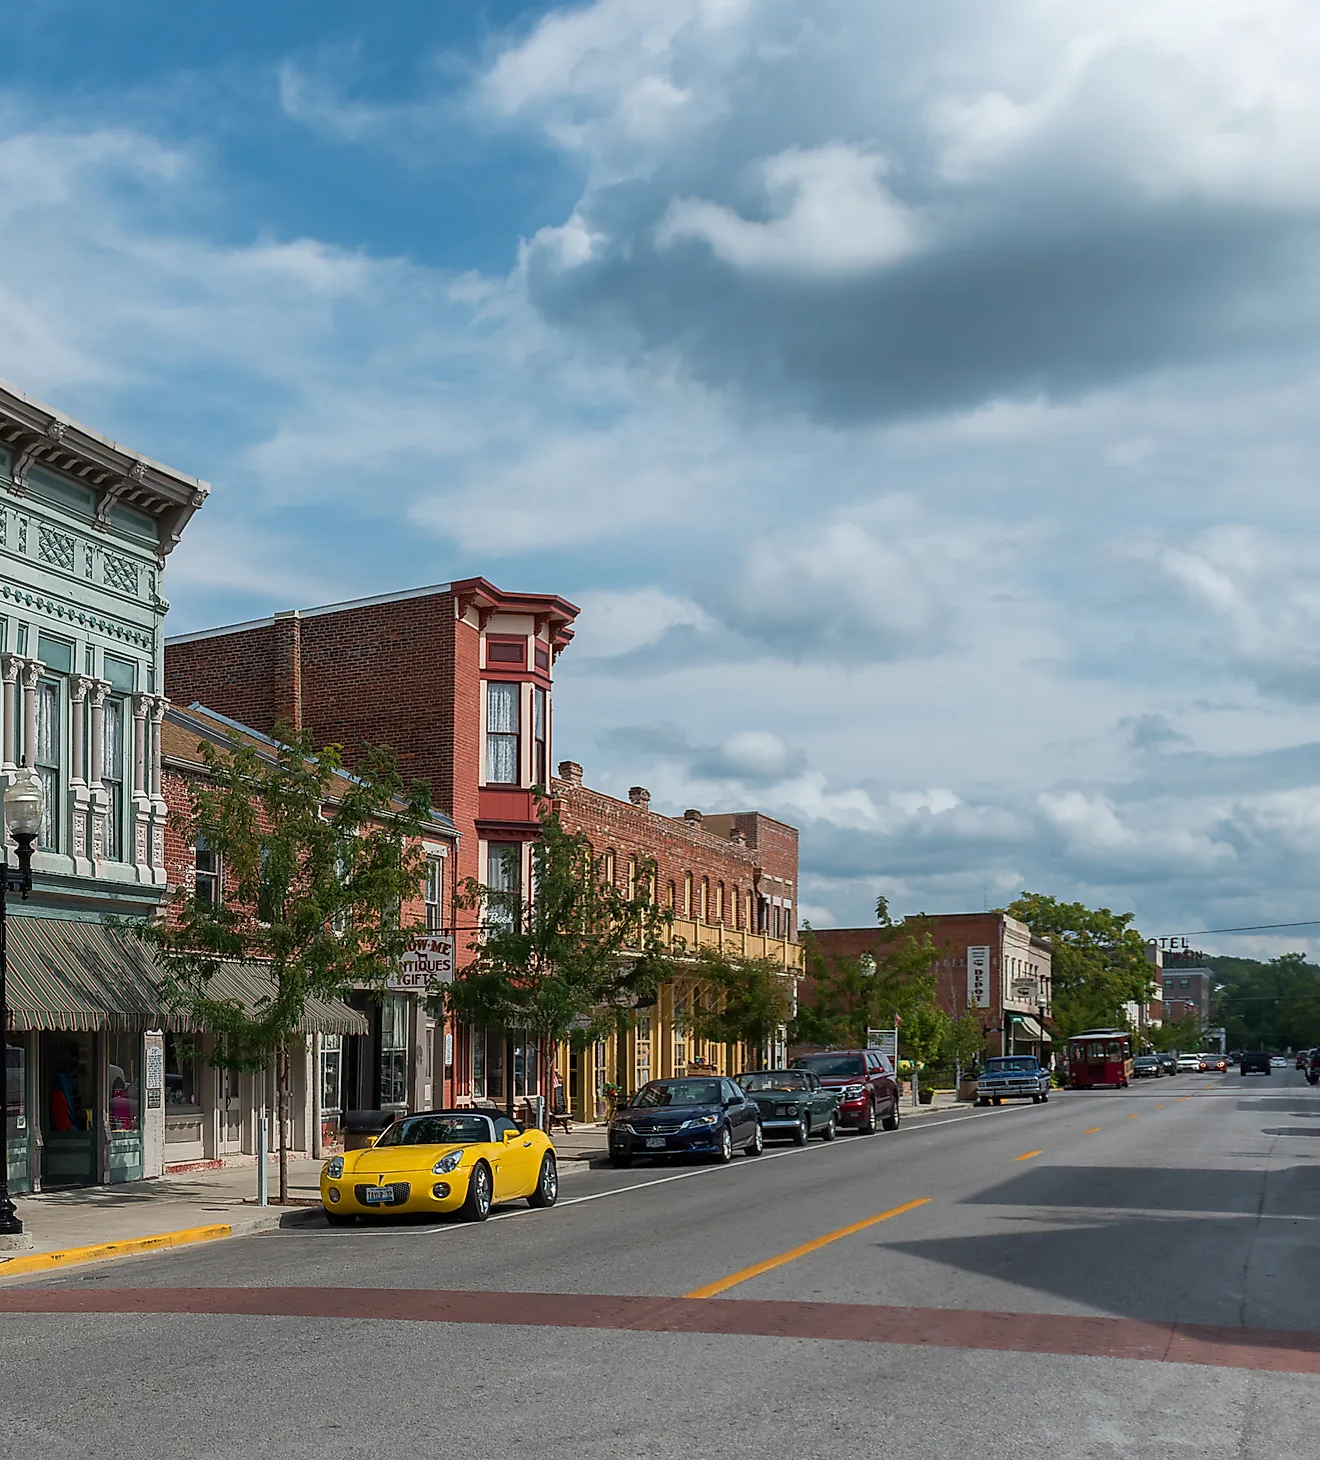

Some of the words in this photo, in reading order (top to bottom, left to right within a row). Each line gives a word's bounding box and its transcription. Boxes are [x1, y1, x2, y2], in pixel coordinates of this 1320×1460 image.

[1141, 937, 1190, 949] OTEL
[399, 960, 451, 973] NTIQUES
[974, 969, 984, 1001] DEPOT
